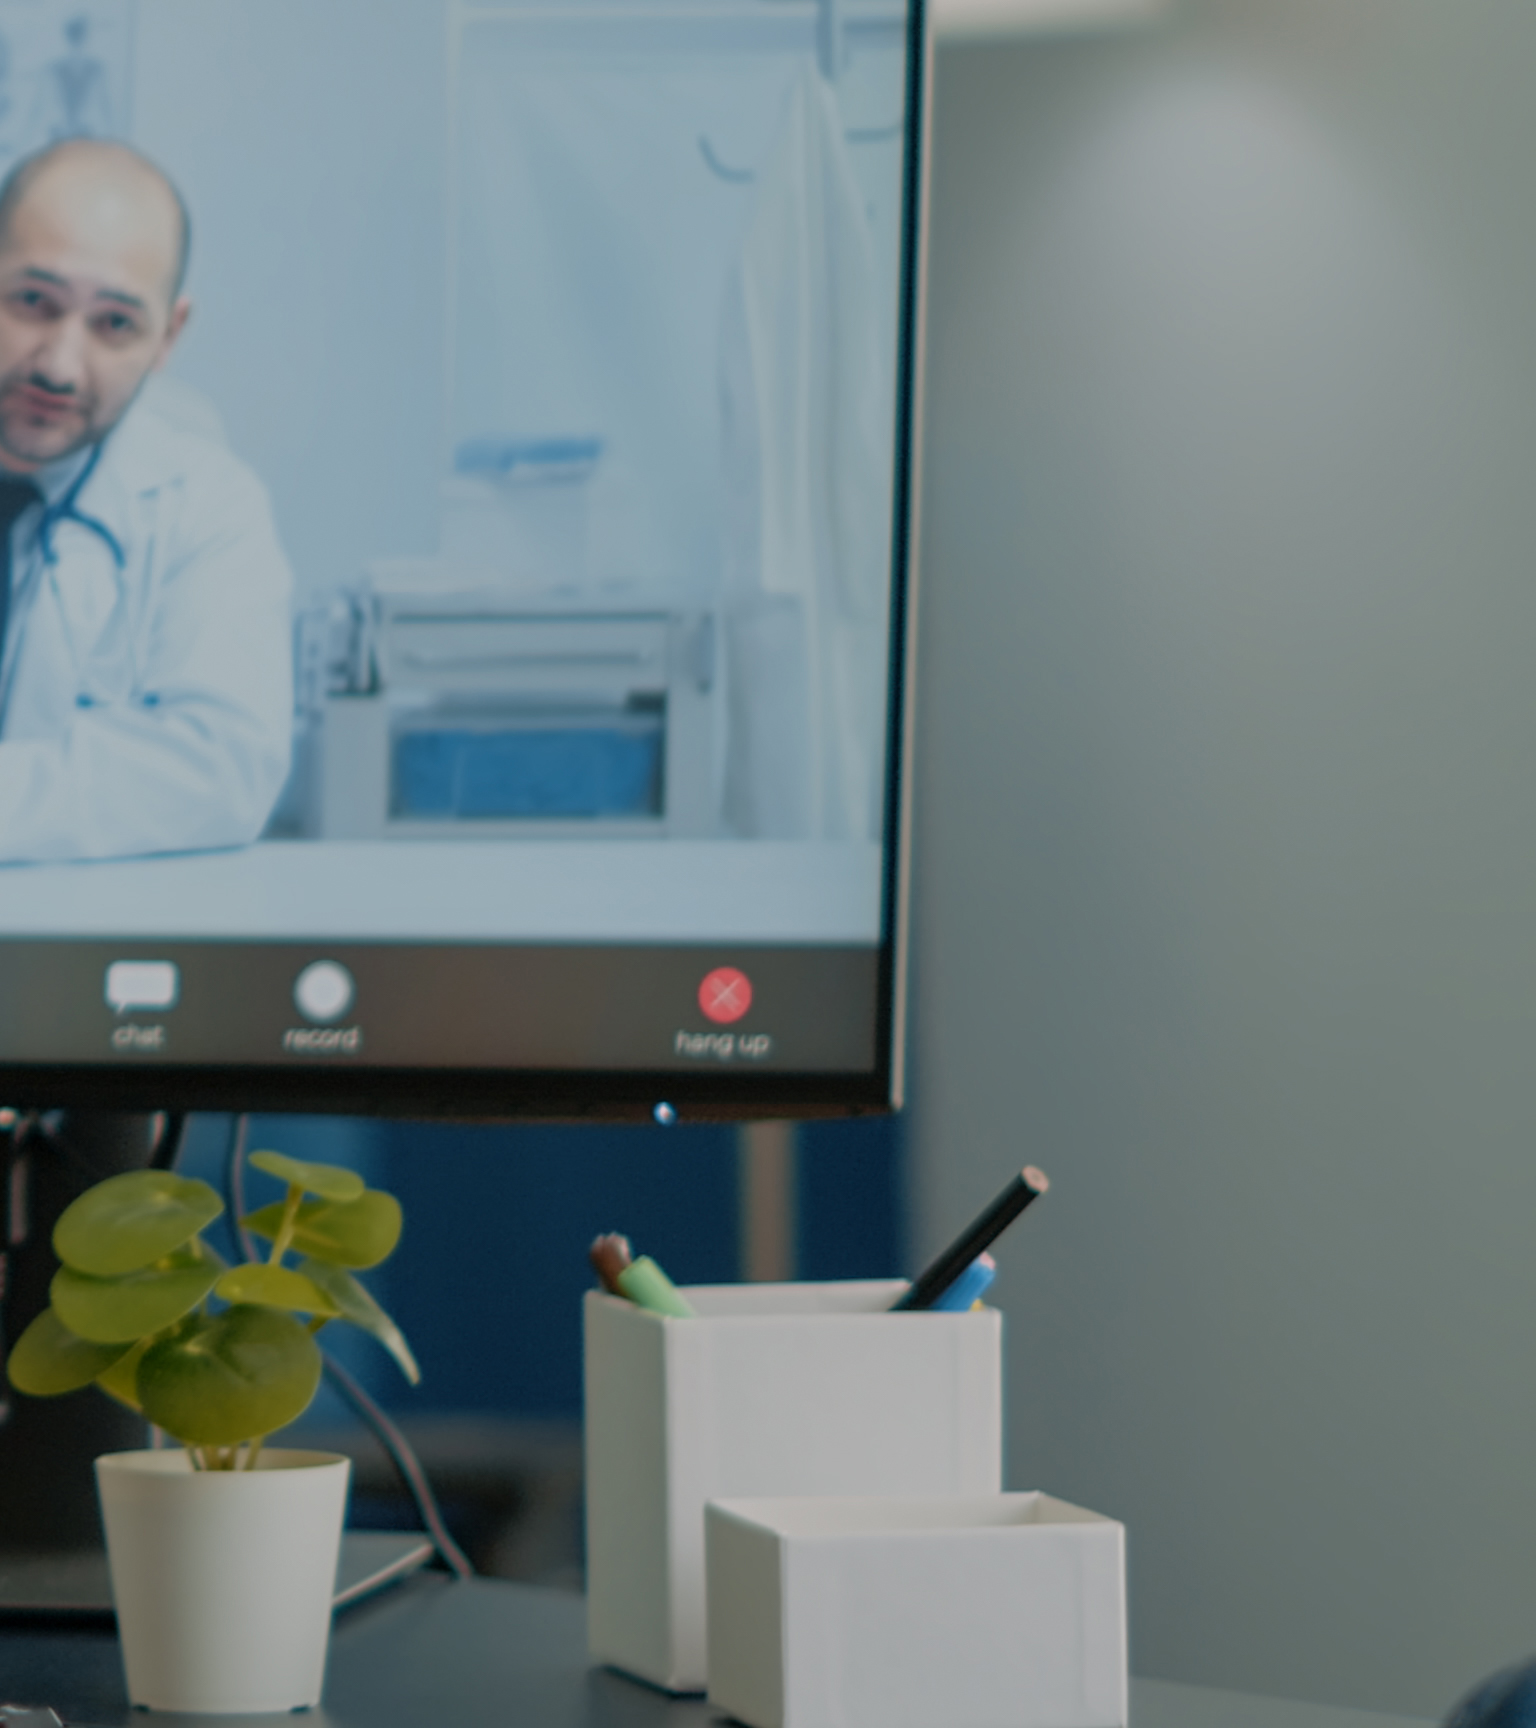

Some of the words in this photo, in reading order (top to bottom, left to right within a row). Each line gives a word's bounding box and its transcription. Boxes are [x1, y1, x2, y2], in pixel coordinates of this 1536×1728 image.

[111, 1022, 164, 1049] chat
[284, 1025, 360, 1051] record
[675, 1029, 734, 1059] hang
[738, 1035, 770, 1058] up
